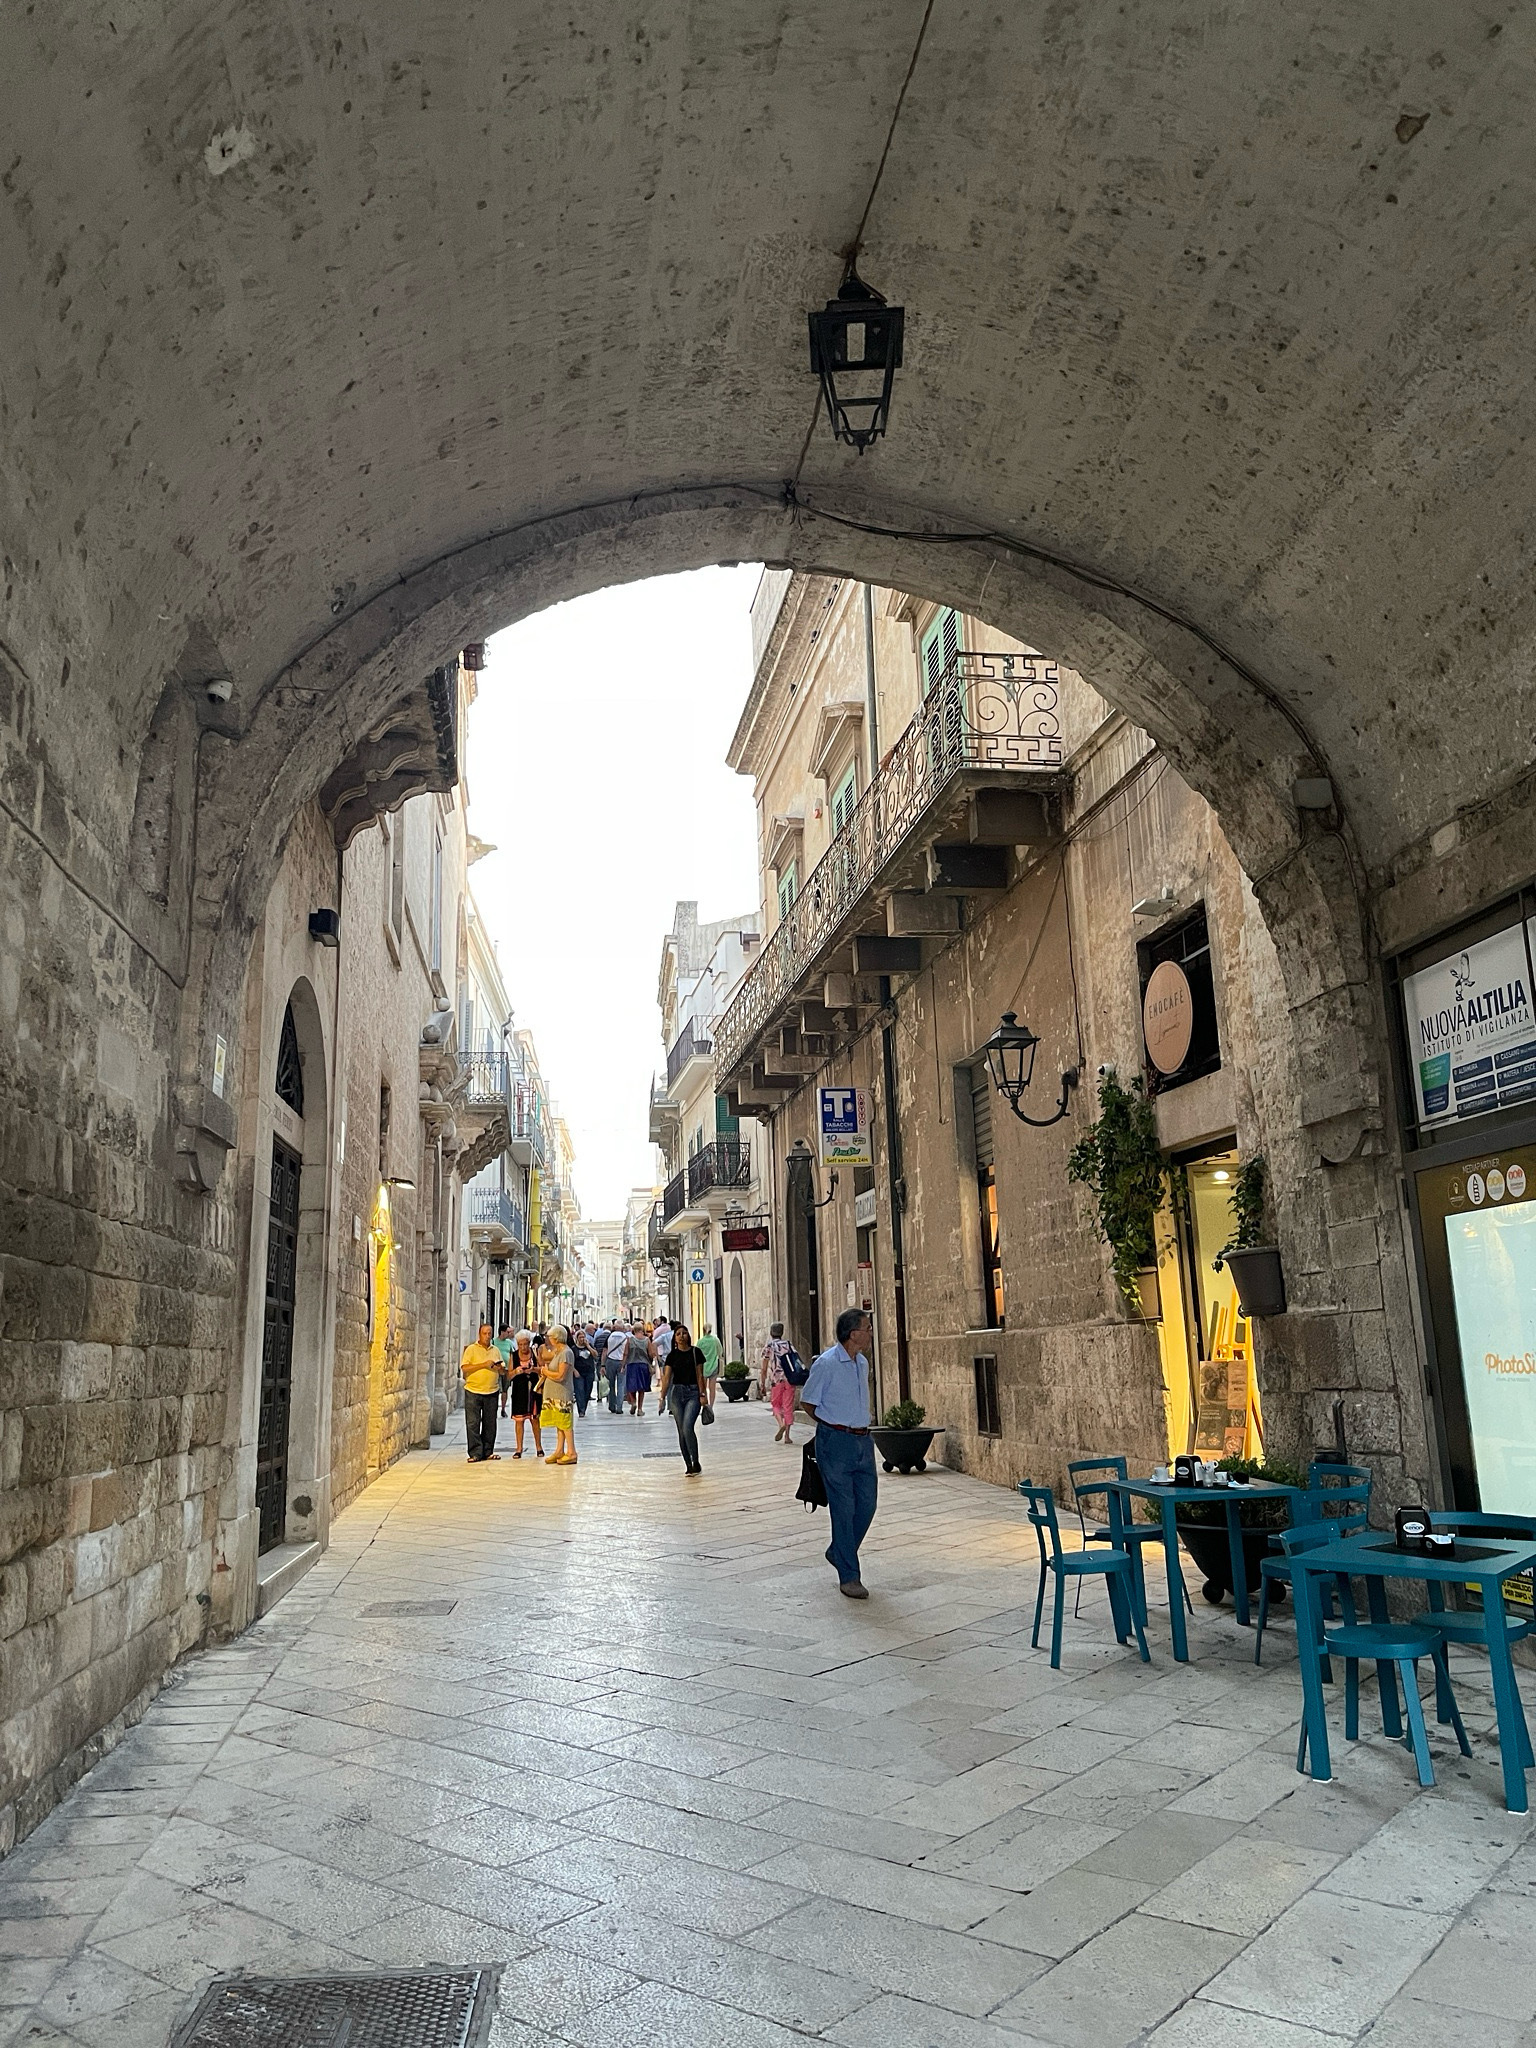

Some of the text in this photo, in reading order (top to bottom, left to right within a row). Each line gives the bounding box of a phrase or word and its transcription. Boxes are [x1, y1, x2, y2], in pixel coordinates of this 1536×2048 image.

[1423, 1033, 1462, 1058] ISTITUTO
[1466, 1029, 1475, 1042] DI
[1478, 1008, 1530, 1037] VIGILANZA
[825, 1090, 851, 1118] T
[826, 1134, 837, 1143] 10
